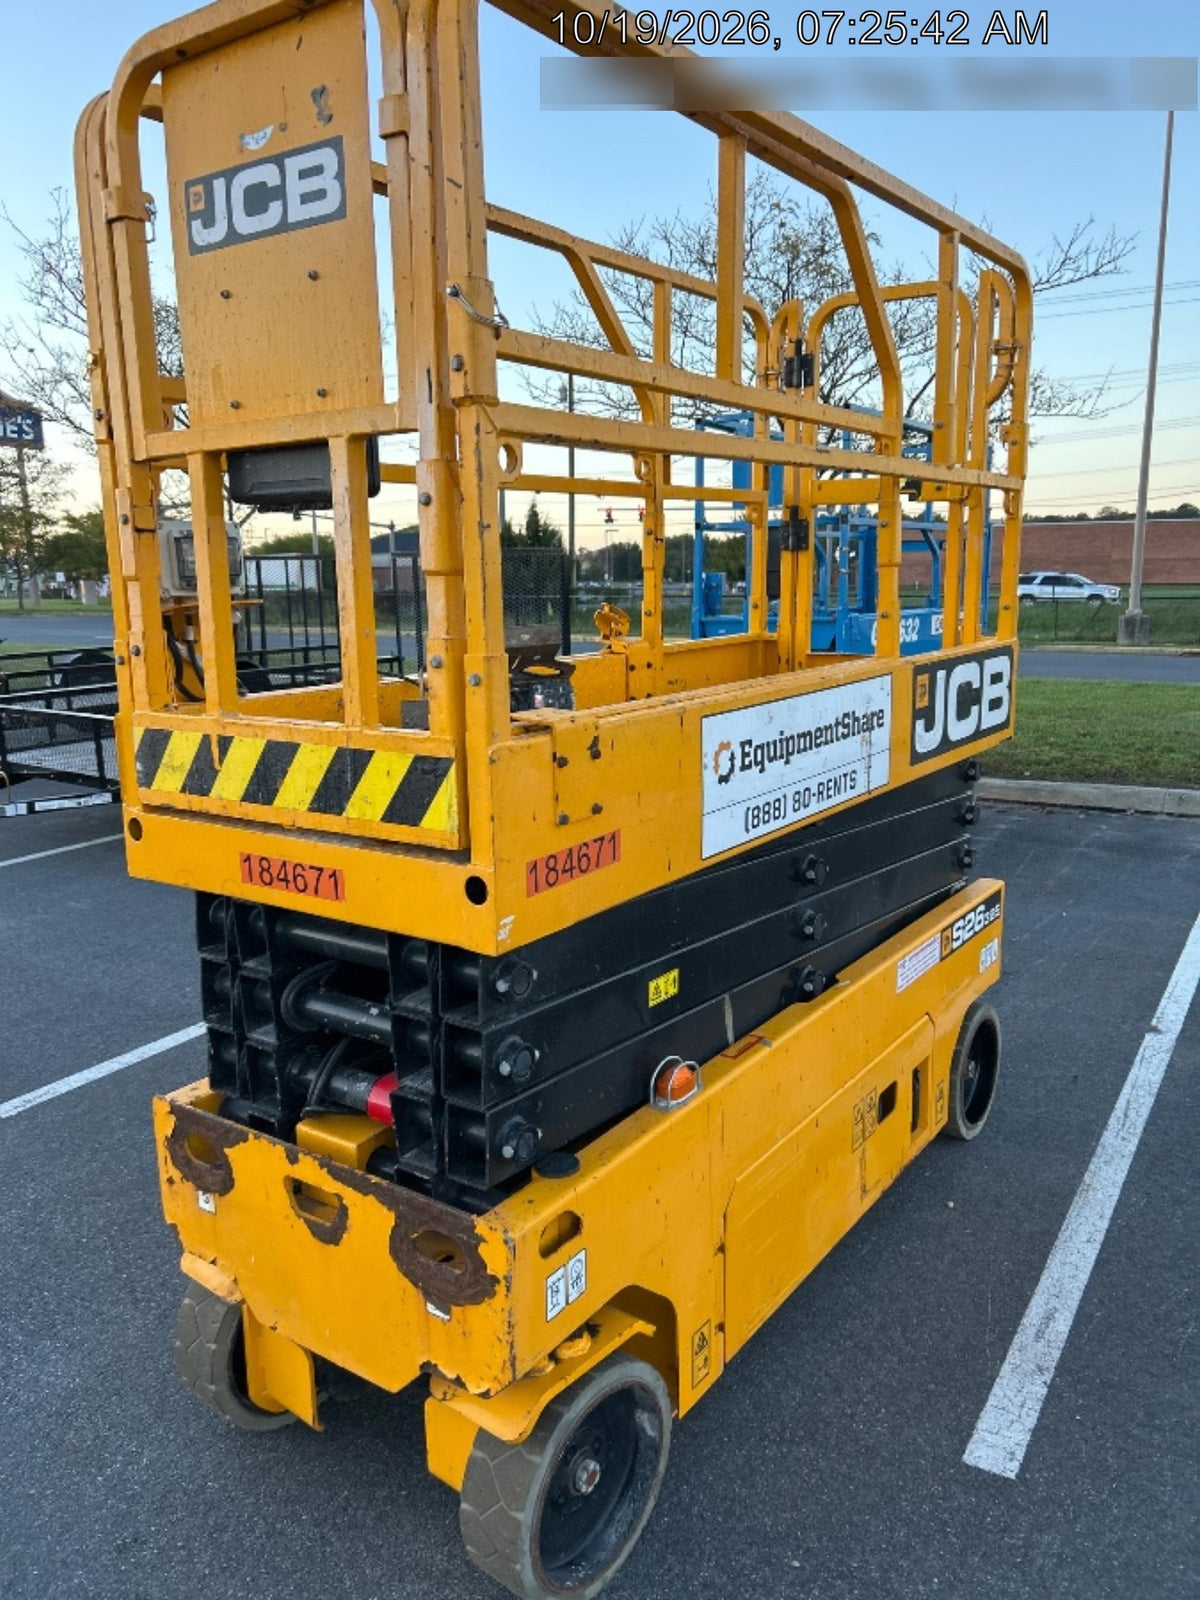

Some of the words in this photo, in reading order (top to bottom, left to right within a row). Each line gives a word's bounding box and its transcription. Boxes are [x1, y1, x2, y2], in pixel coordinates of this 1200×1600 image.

[191, 147, 341, 246] JCB
[914, 655, 1010, 752] JCB
[739, 708, 885, 773] EquipmentShare
[744, 793, 787, 833] (888)
[792, 769, 857, 812] 80-RENTS
[242, 854, 340, 899] 184671
[529, 833, 617, 893] 184671
